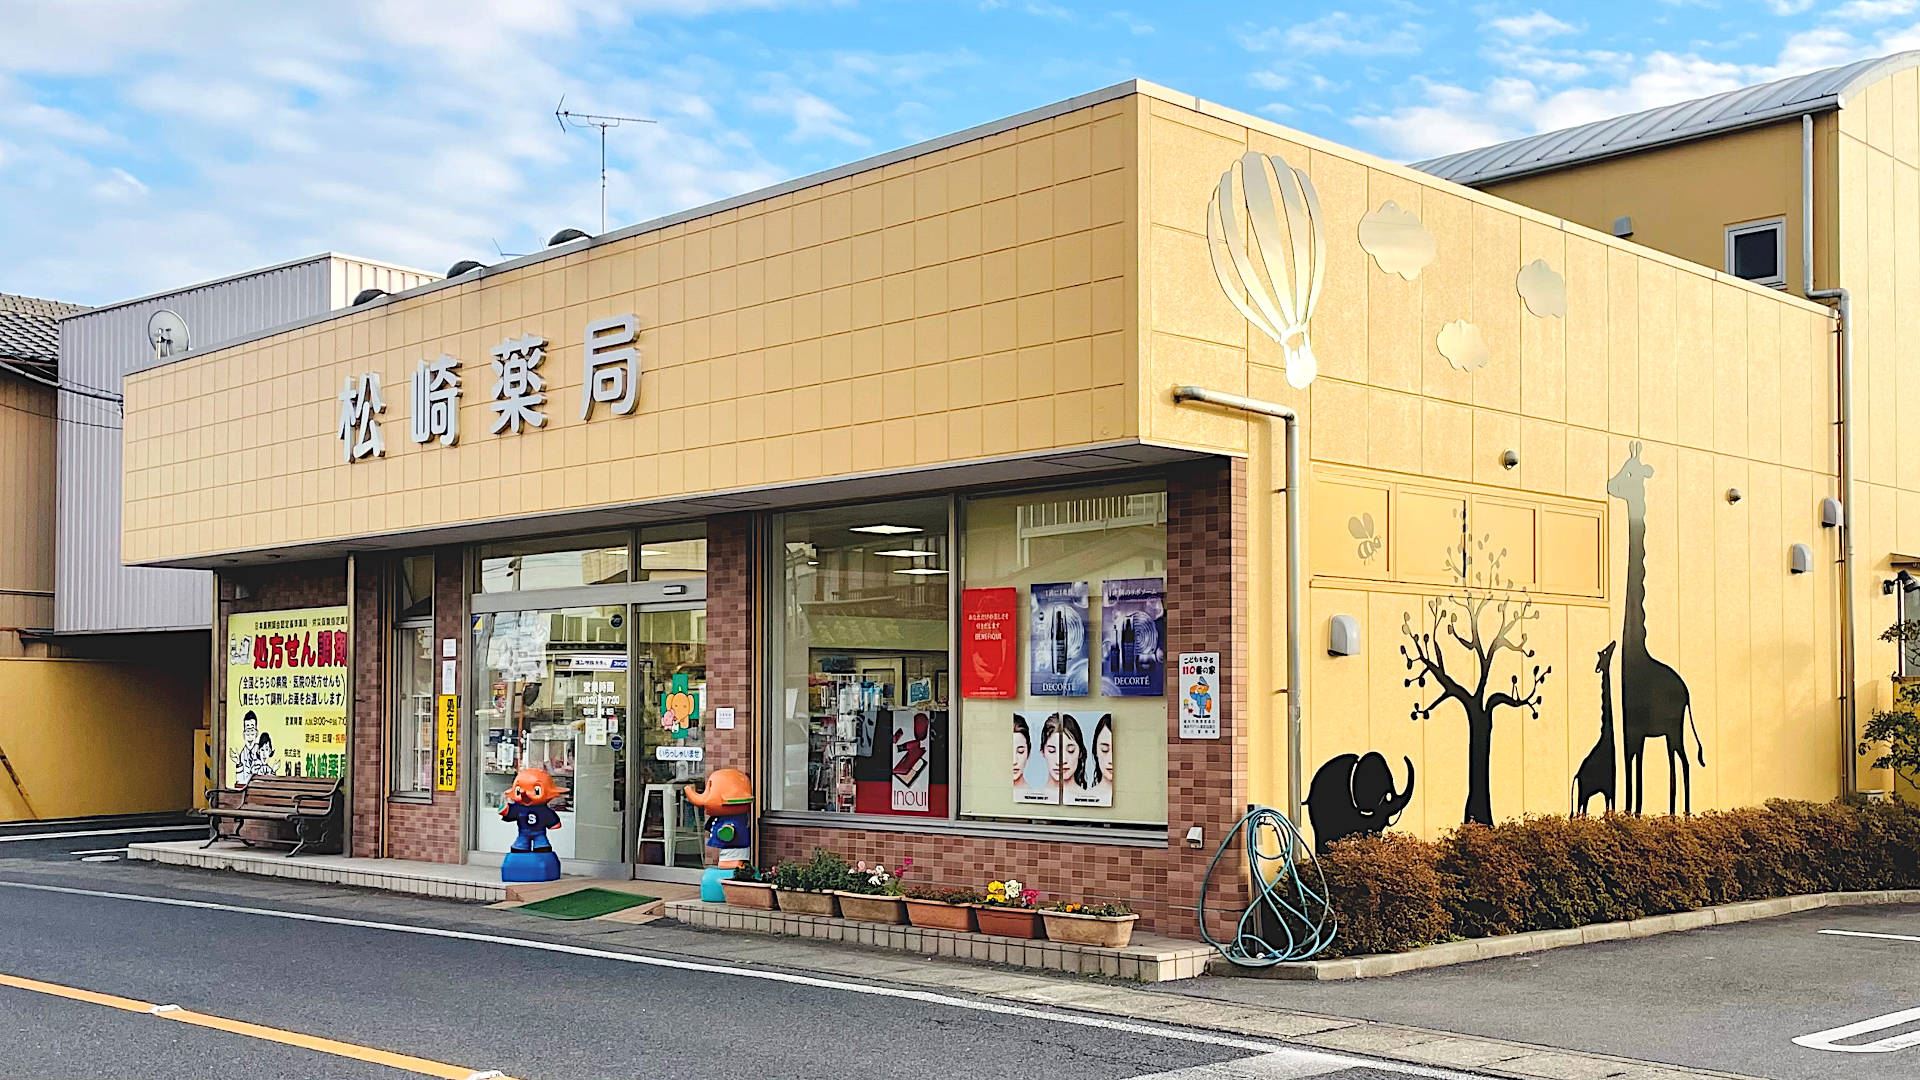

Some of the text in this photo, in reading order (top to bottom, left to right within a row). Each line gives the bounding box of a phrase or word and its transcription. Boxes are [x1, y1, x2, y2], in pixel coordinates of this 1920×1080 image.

[338, 313, 641, 463] 松崎薬局
[446, 698, 455, 786] 処方せん受付
[527, 813, 537, 825] S
